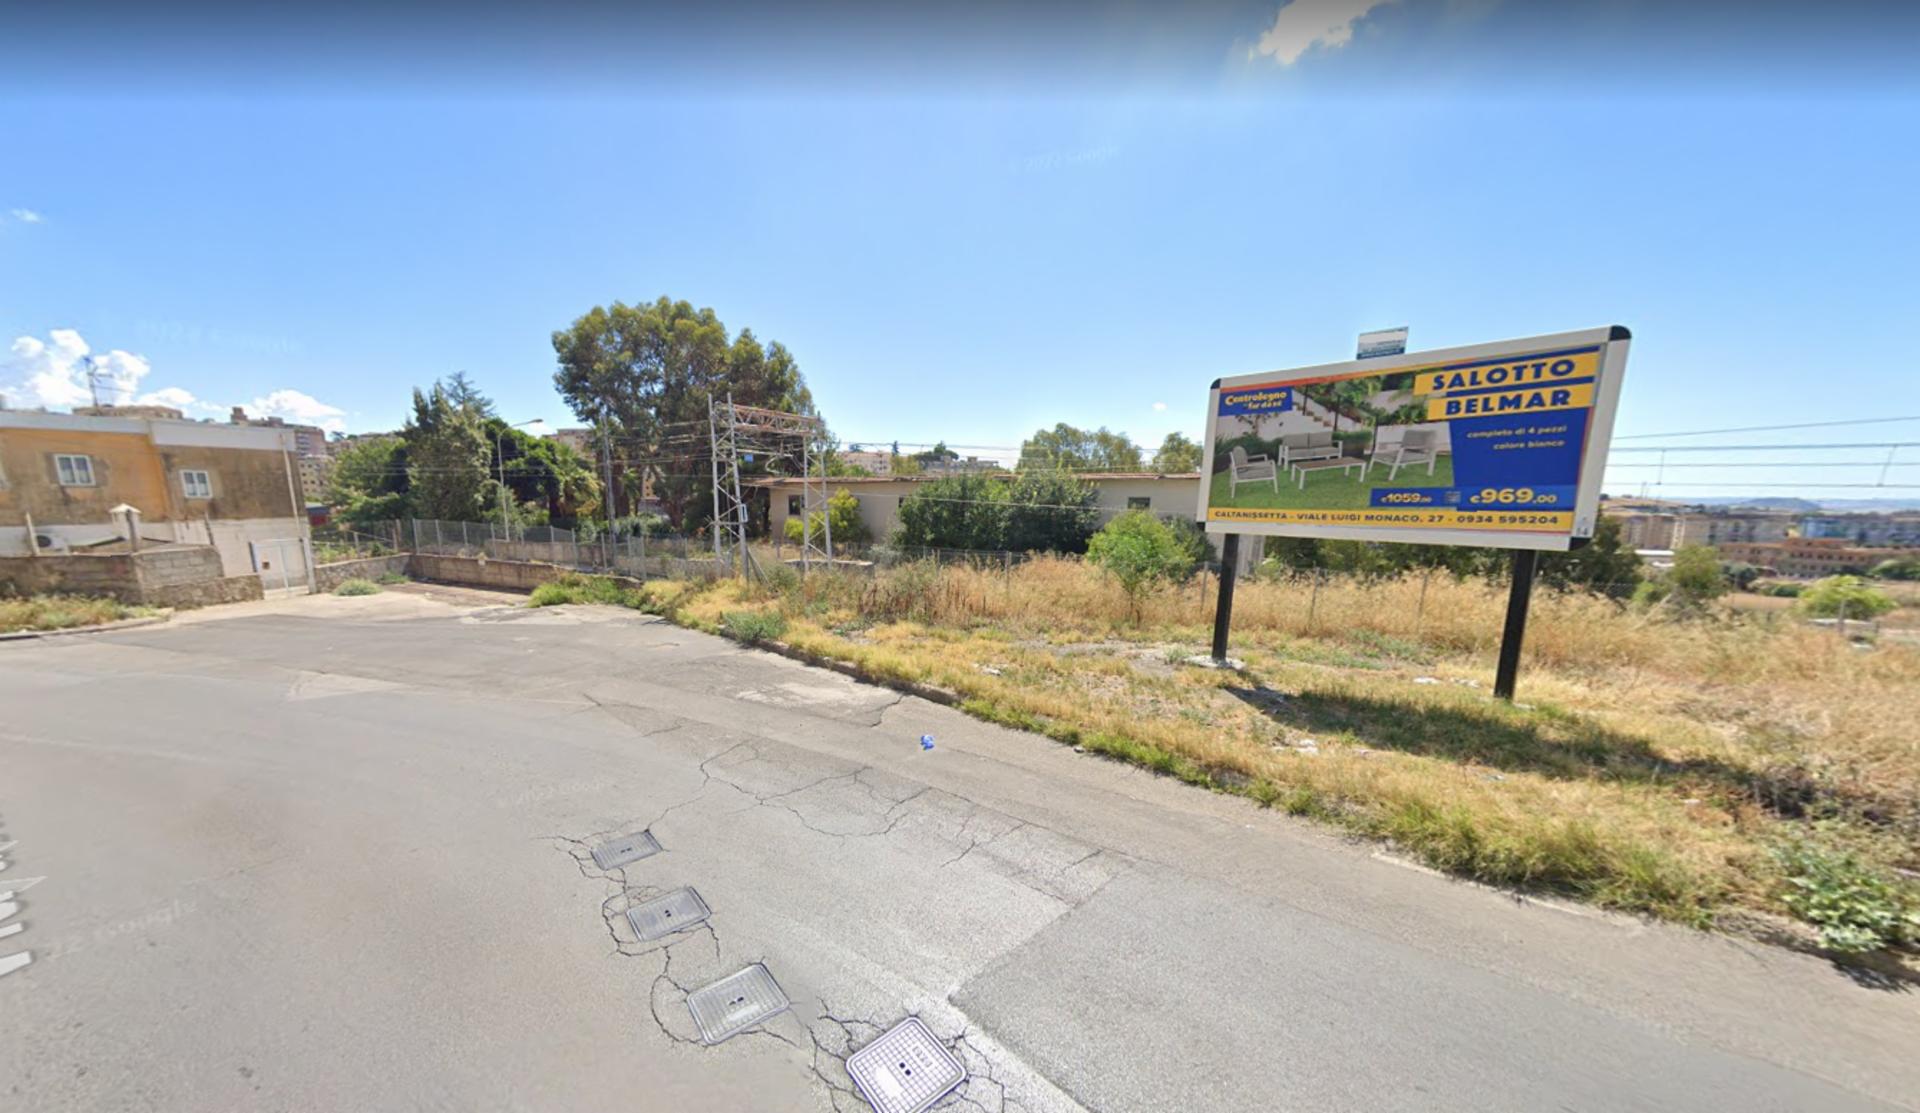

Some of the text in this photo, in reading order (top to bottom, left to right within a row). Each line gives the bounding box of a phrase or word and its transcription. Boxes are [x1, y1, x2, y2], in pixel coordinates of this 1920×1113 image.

[1432, 359, 1576, 391] SALOTTO
[1225, 392, 1287, 405] Centrolegno
[1445, 389, 1572, 416] BELMAR
[1467, 424, 1568, 439] completo di 4 pezzi
[1493, 440, 1566, 450] colore bianco
[1214, 511, 1288, 519] CALTANISSETTA
[1330, 514, 1361, 522] LUIGI
[1428, 515, 1445, 523] 27
[1457, 515, 1493, 524] 0934
[1499, 515, 1559, 524] 595204
